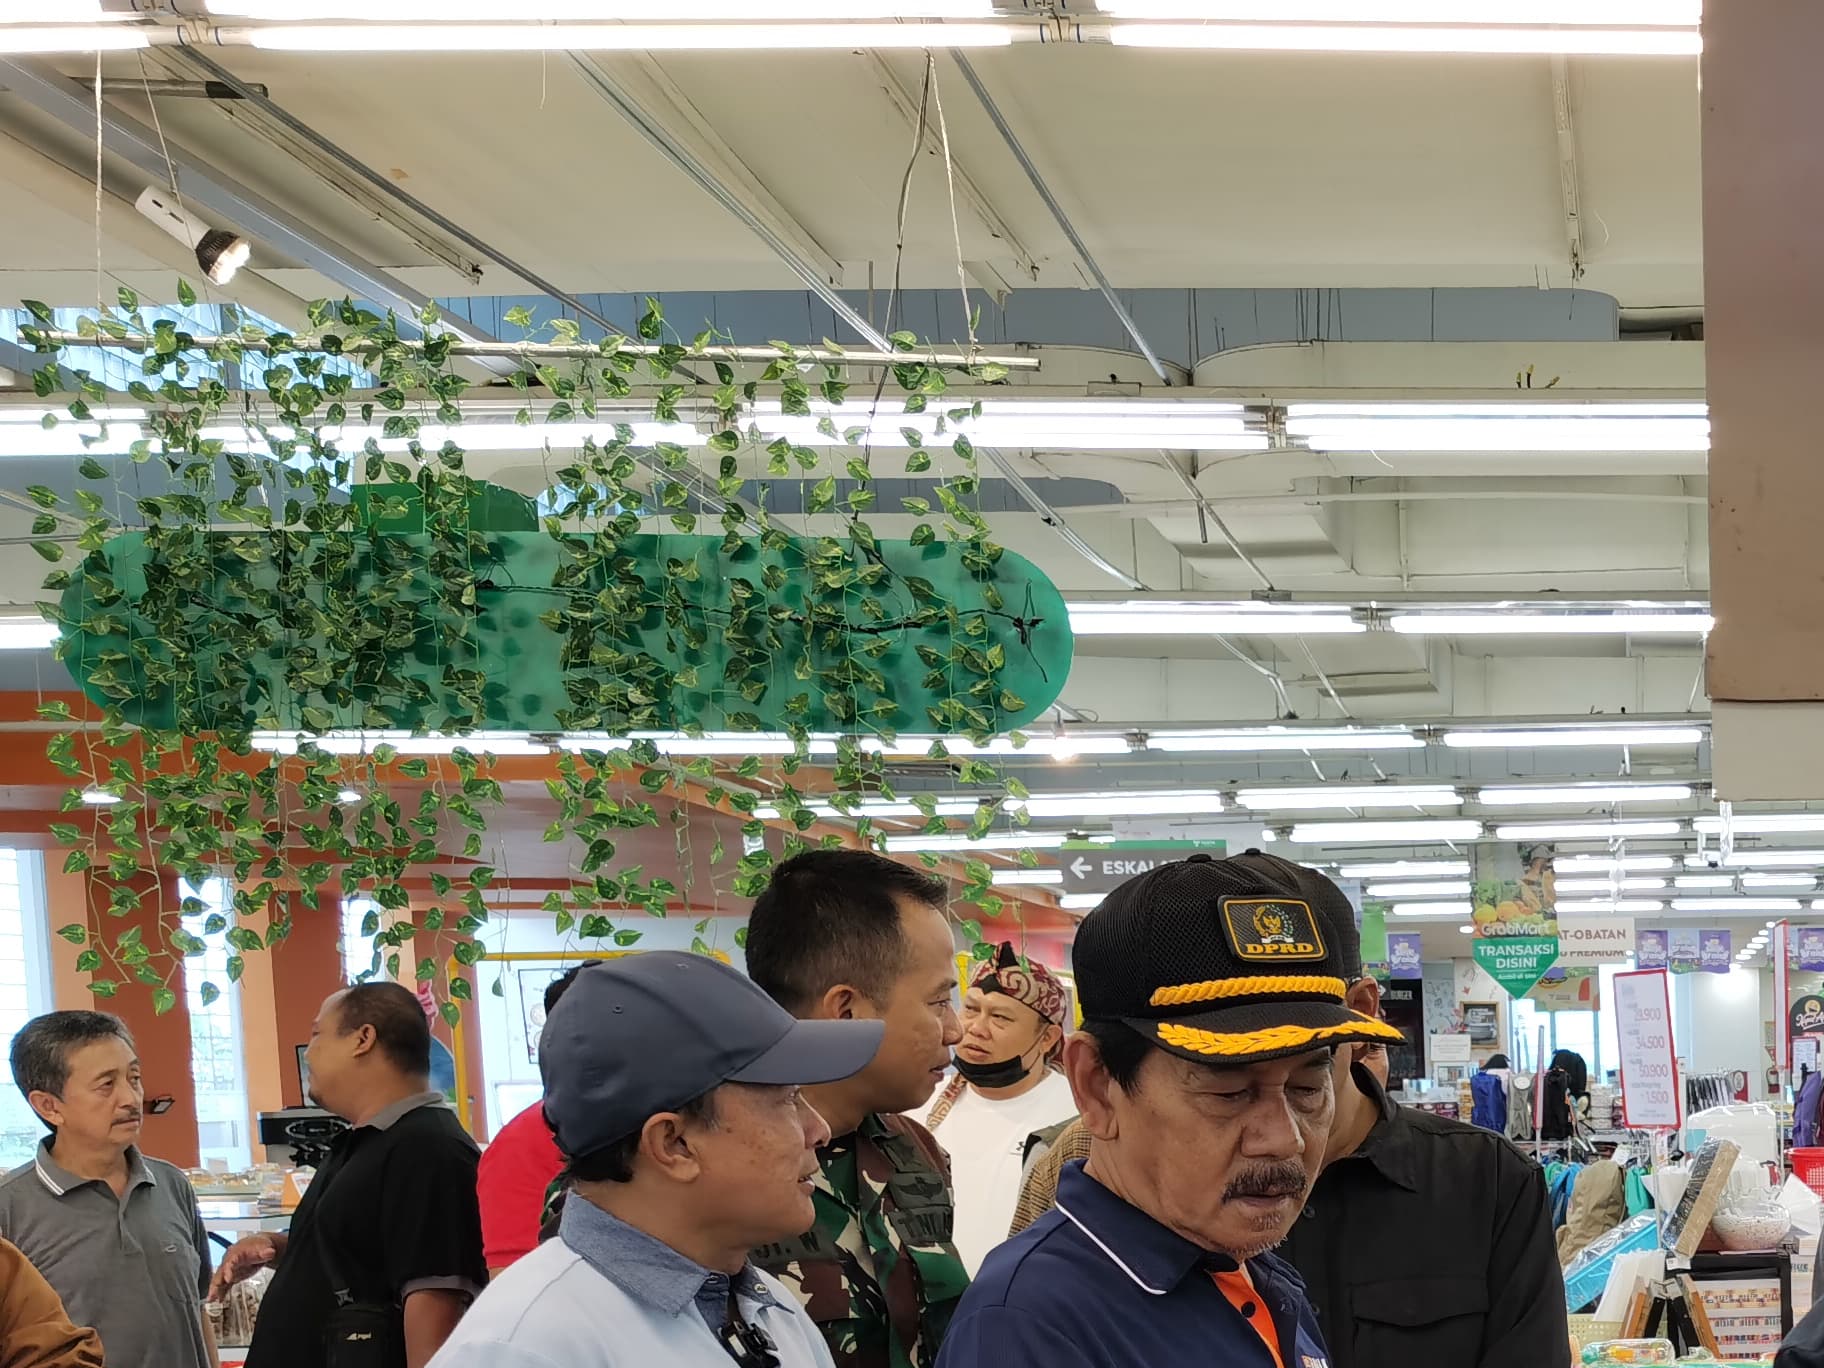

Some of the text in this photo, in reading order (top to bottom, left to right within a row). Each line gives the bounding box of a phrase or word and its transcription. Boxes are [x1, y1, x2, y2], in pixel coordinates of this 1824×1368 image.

[1481, 921, 1551, 936] GrabMart
[1245, 943, 1315, 955] DPRD
[1478, 944, 1554, 956] TRANSAKSI
[1495, 957, 1537, 968] DISINI
